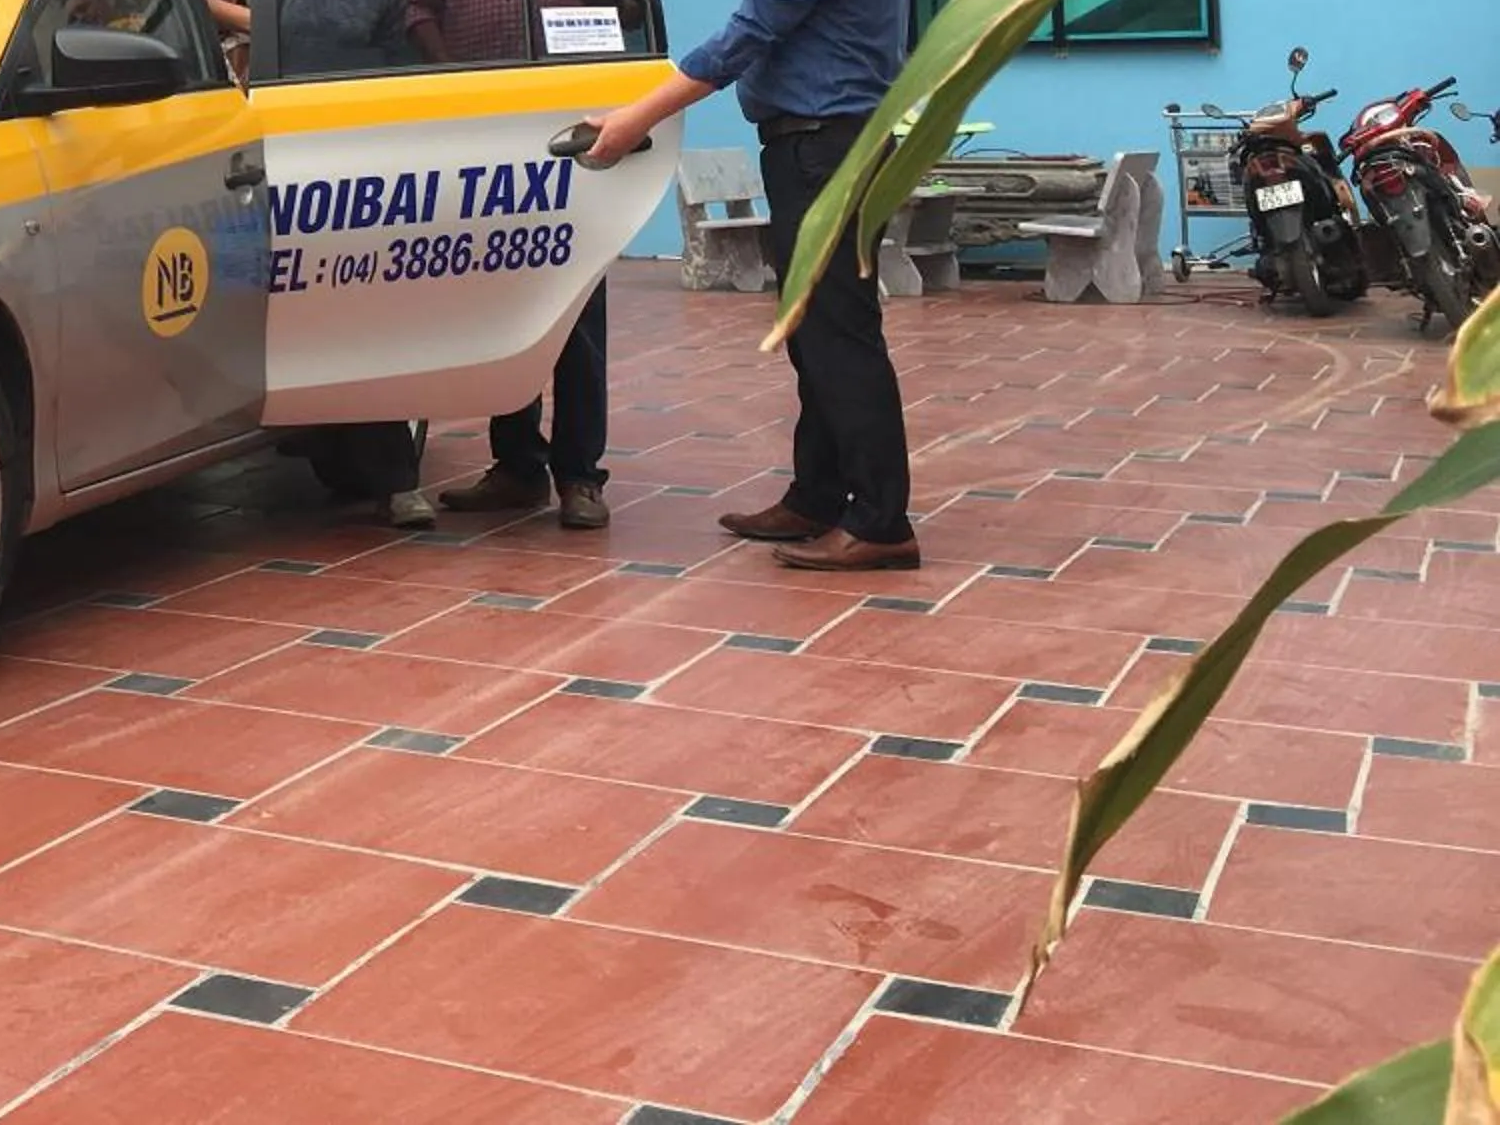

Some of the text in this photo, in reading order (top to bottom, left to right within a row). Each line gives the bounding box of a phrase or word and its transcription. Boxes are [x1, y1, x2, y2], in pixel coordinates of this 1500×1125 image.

[267, 158, 573, 236] NOIBAI TAXI
[268, 247, 326, 293] EL:
[382, 222, 574, 282] 3886.8888
